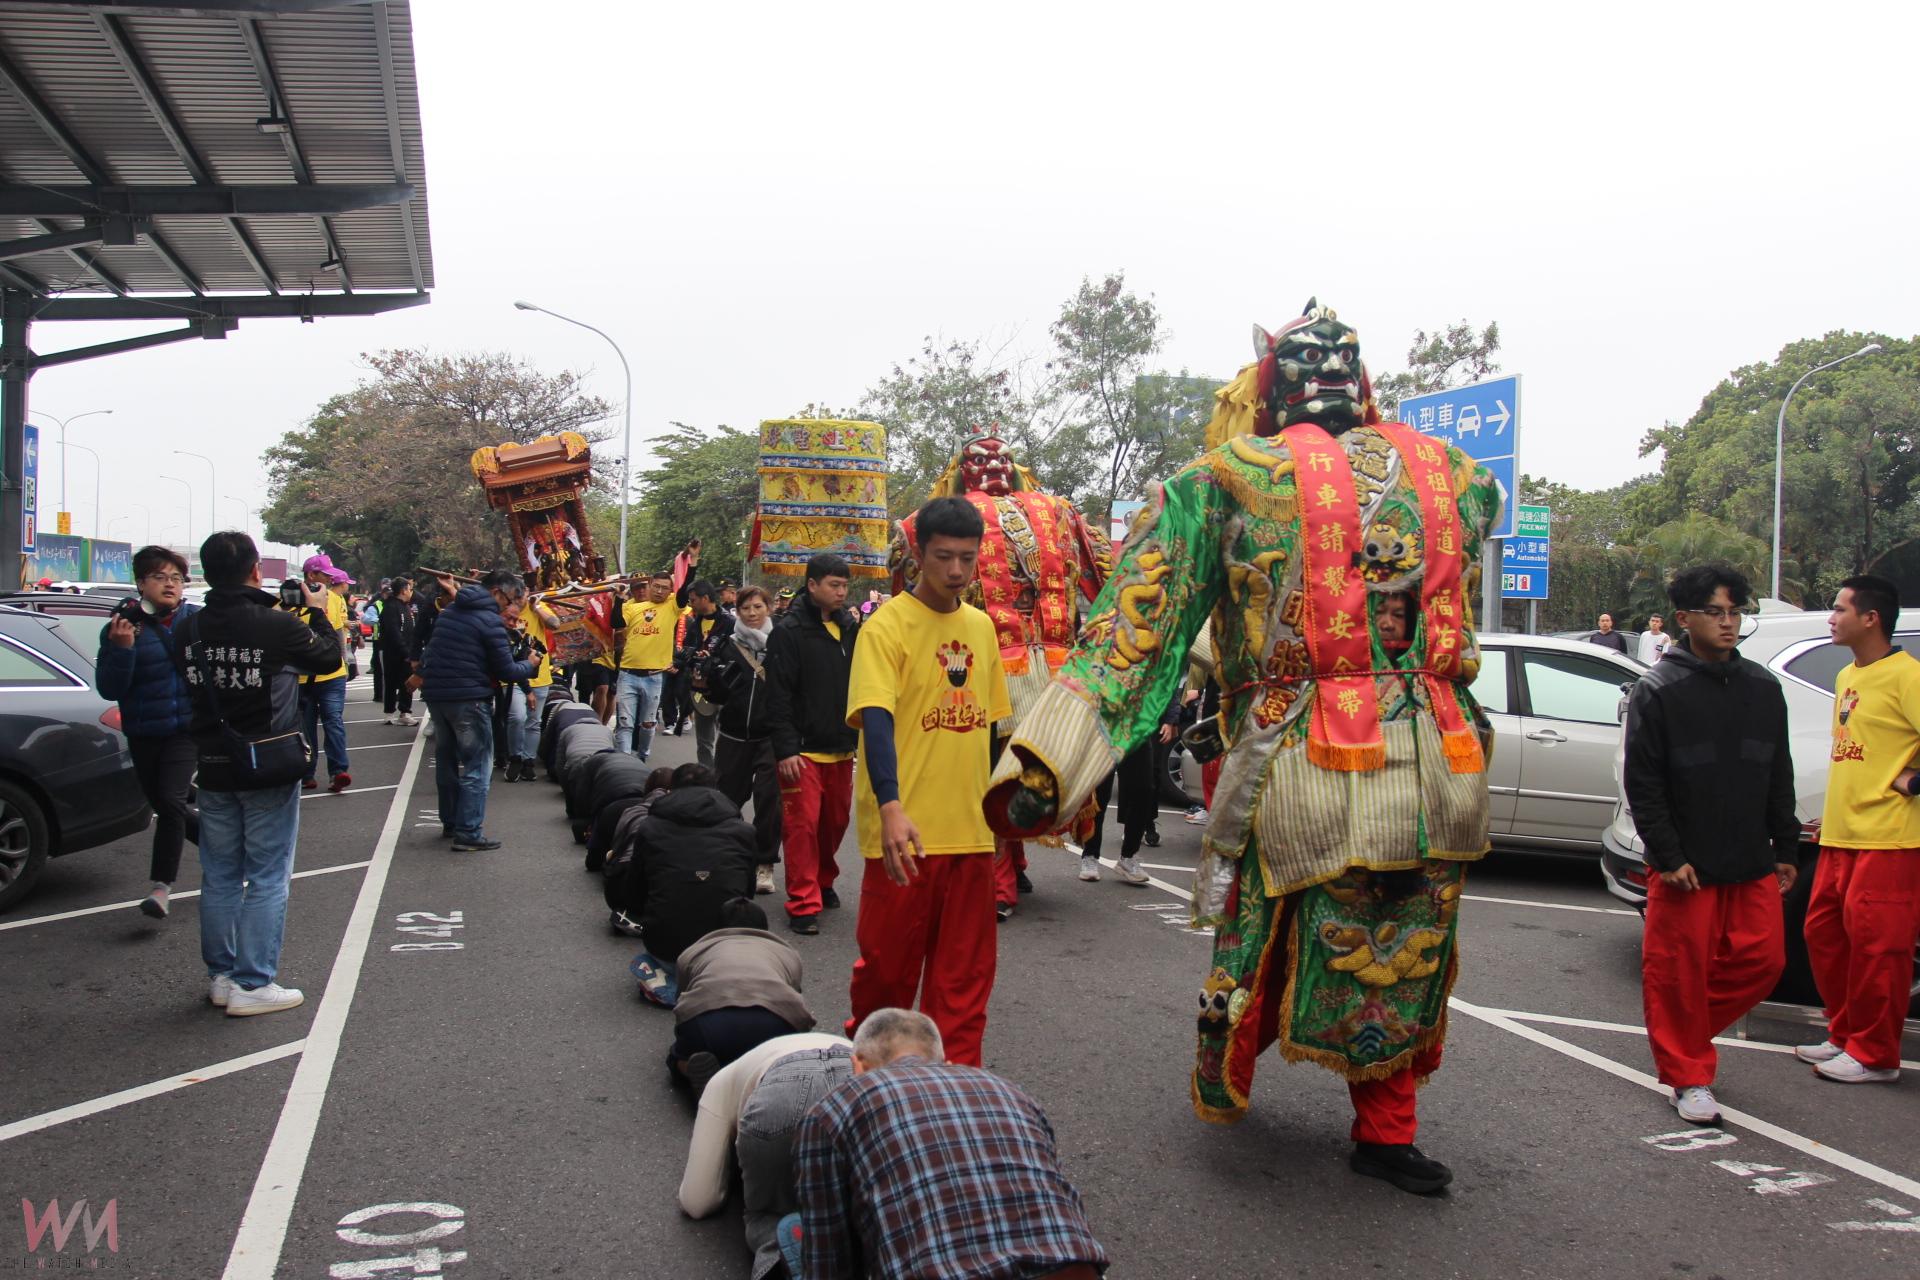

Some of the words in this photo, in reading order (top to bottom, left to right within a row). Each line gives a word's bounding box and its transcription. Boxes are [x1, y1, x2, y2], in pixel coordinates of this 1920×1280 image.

[1403, 402, 1455, 434] 小型車
[1518, 511, 1548, 524] 高速公路
[1519, 523, 1547, 531] FREEWAY
[1517, 541, 1548, 554] 小型車
[1516, 554, 1547, 563] Automobile
[1308, 451, 1365, 721] 行車請繫安全帶
[186, 666, 263, 690] 西老大媽
[921, 704, 987, 733] 國道媽祖
